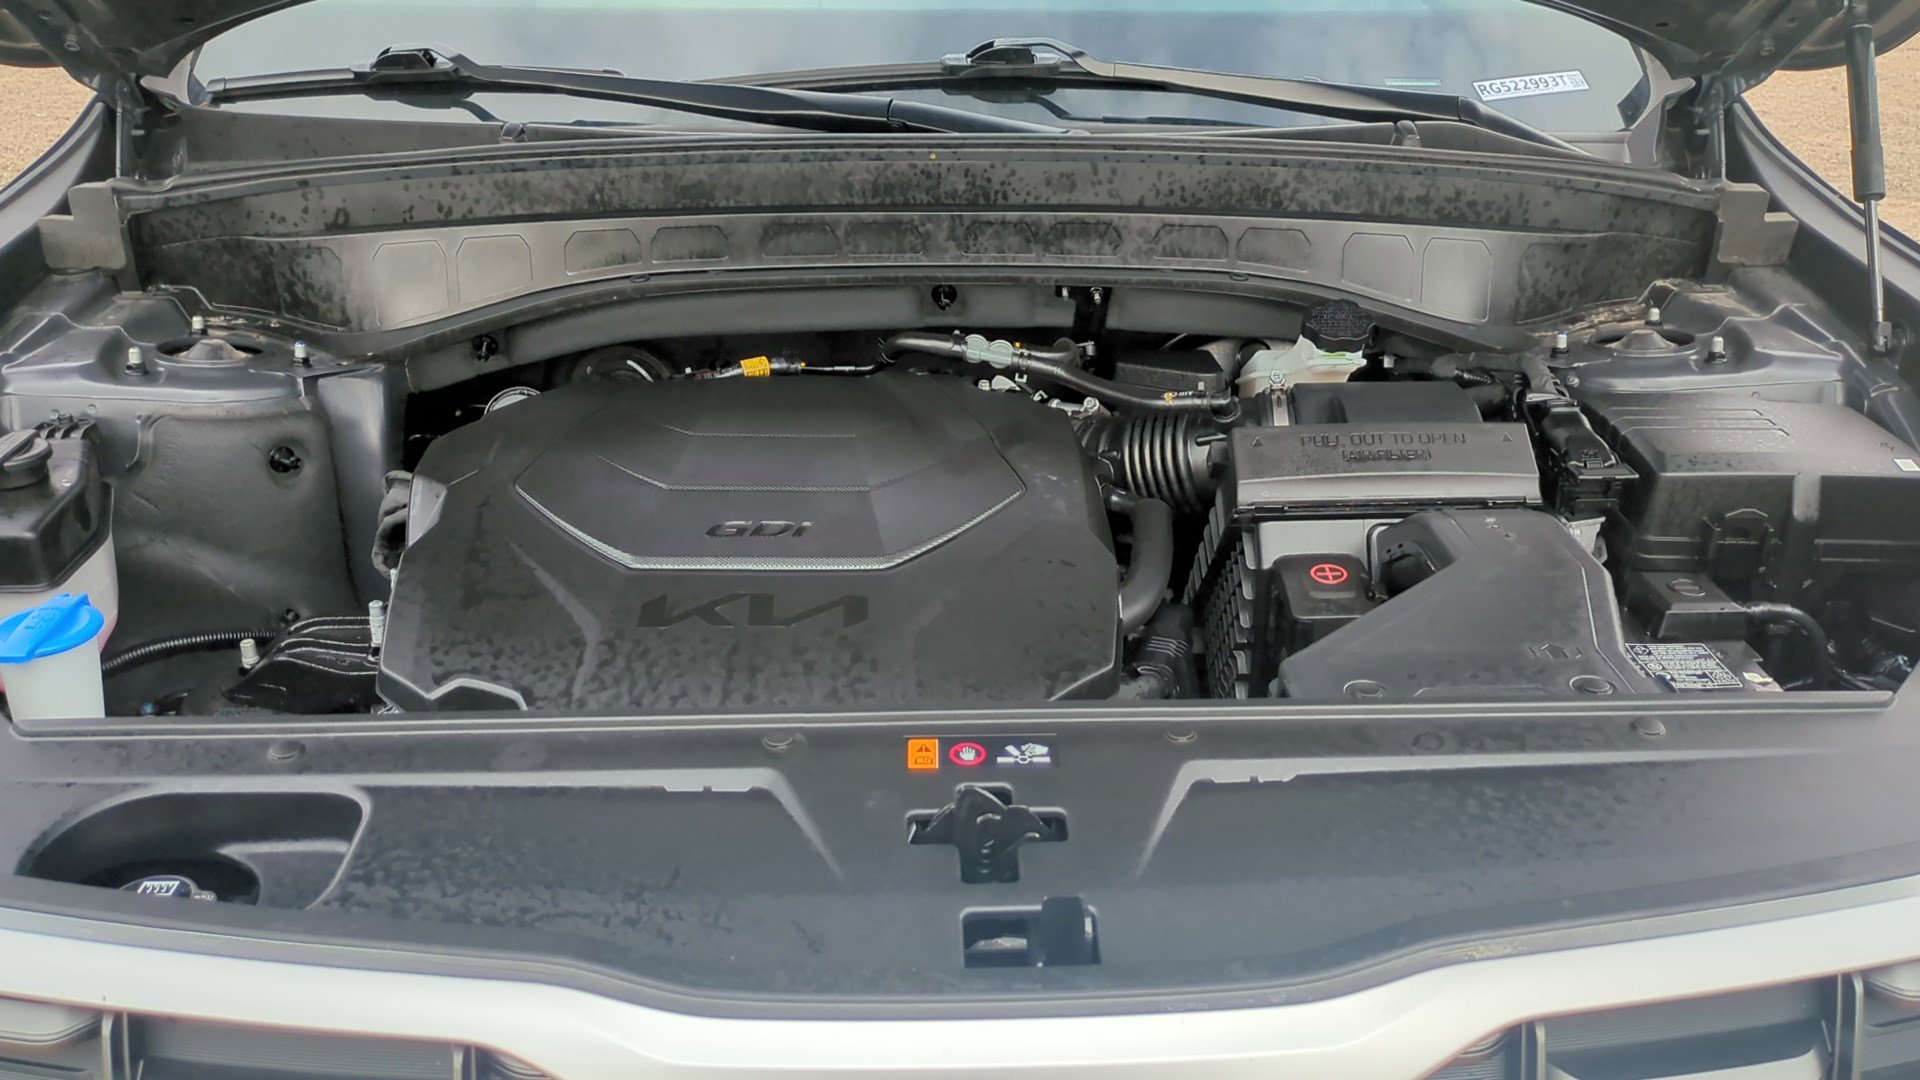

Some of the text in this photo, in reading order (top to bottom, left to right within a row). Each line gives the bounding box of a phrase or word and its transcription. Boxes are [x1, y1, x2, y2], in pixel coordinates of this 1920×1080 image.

[1477, 74, 1568, 96] RG522993T
[1350, 432, 1384, 446] OUT
[1389, 432, 1414, 445] TO
[1418, 431, 1466, 445] OPEN
[637, 591, 869, 628] KIA
